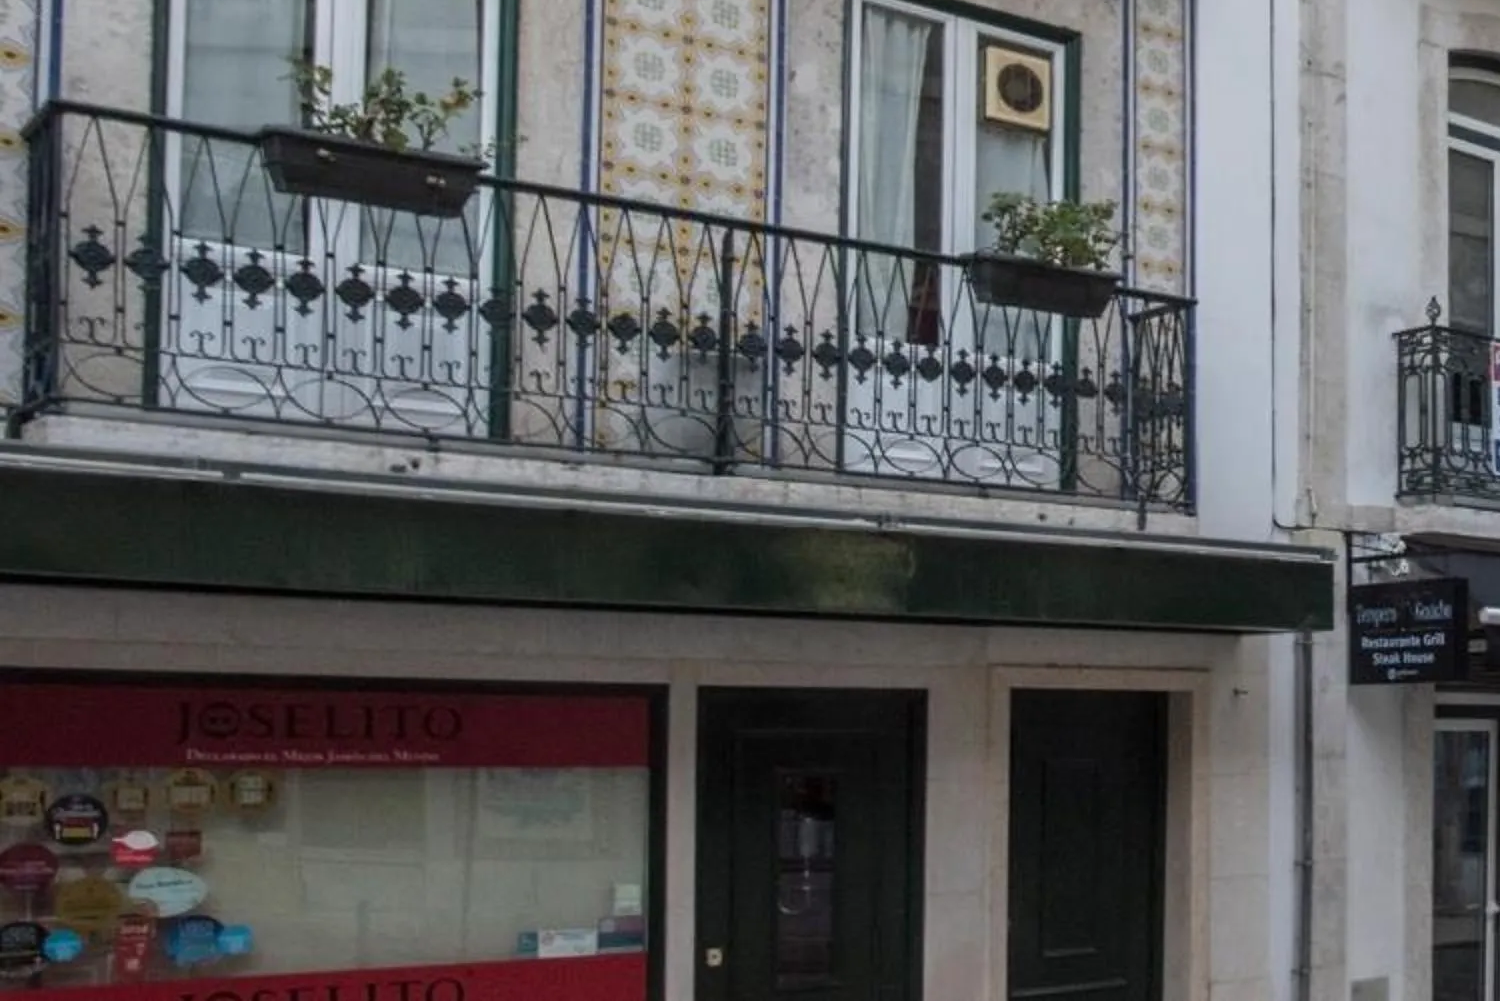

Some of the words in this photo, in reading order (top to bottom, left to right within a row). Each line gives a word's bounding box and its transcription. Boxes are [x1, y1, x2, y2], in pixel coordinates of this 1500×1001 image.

[1361, 636, 1421, 649] Restaurante
[1423, 632, 1446, 647] Grill
[1372, 652, 1400, 665] Steak
[1403, 651, 1435, 664] House
[177, 701, 464, 745] JOSELITO
